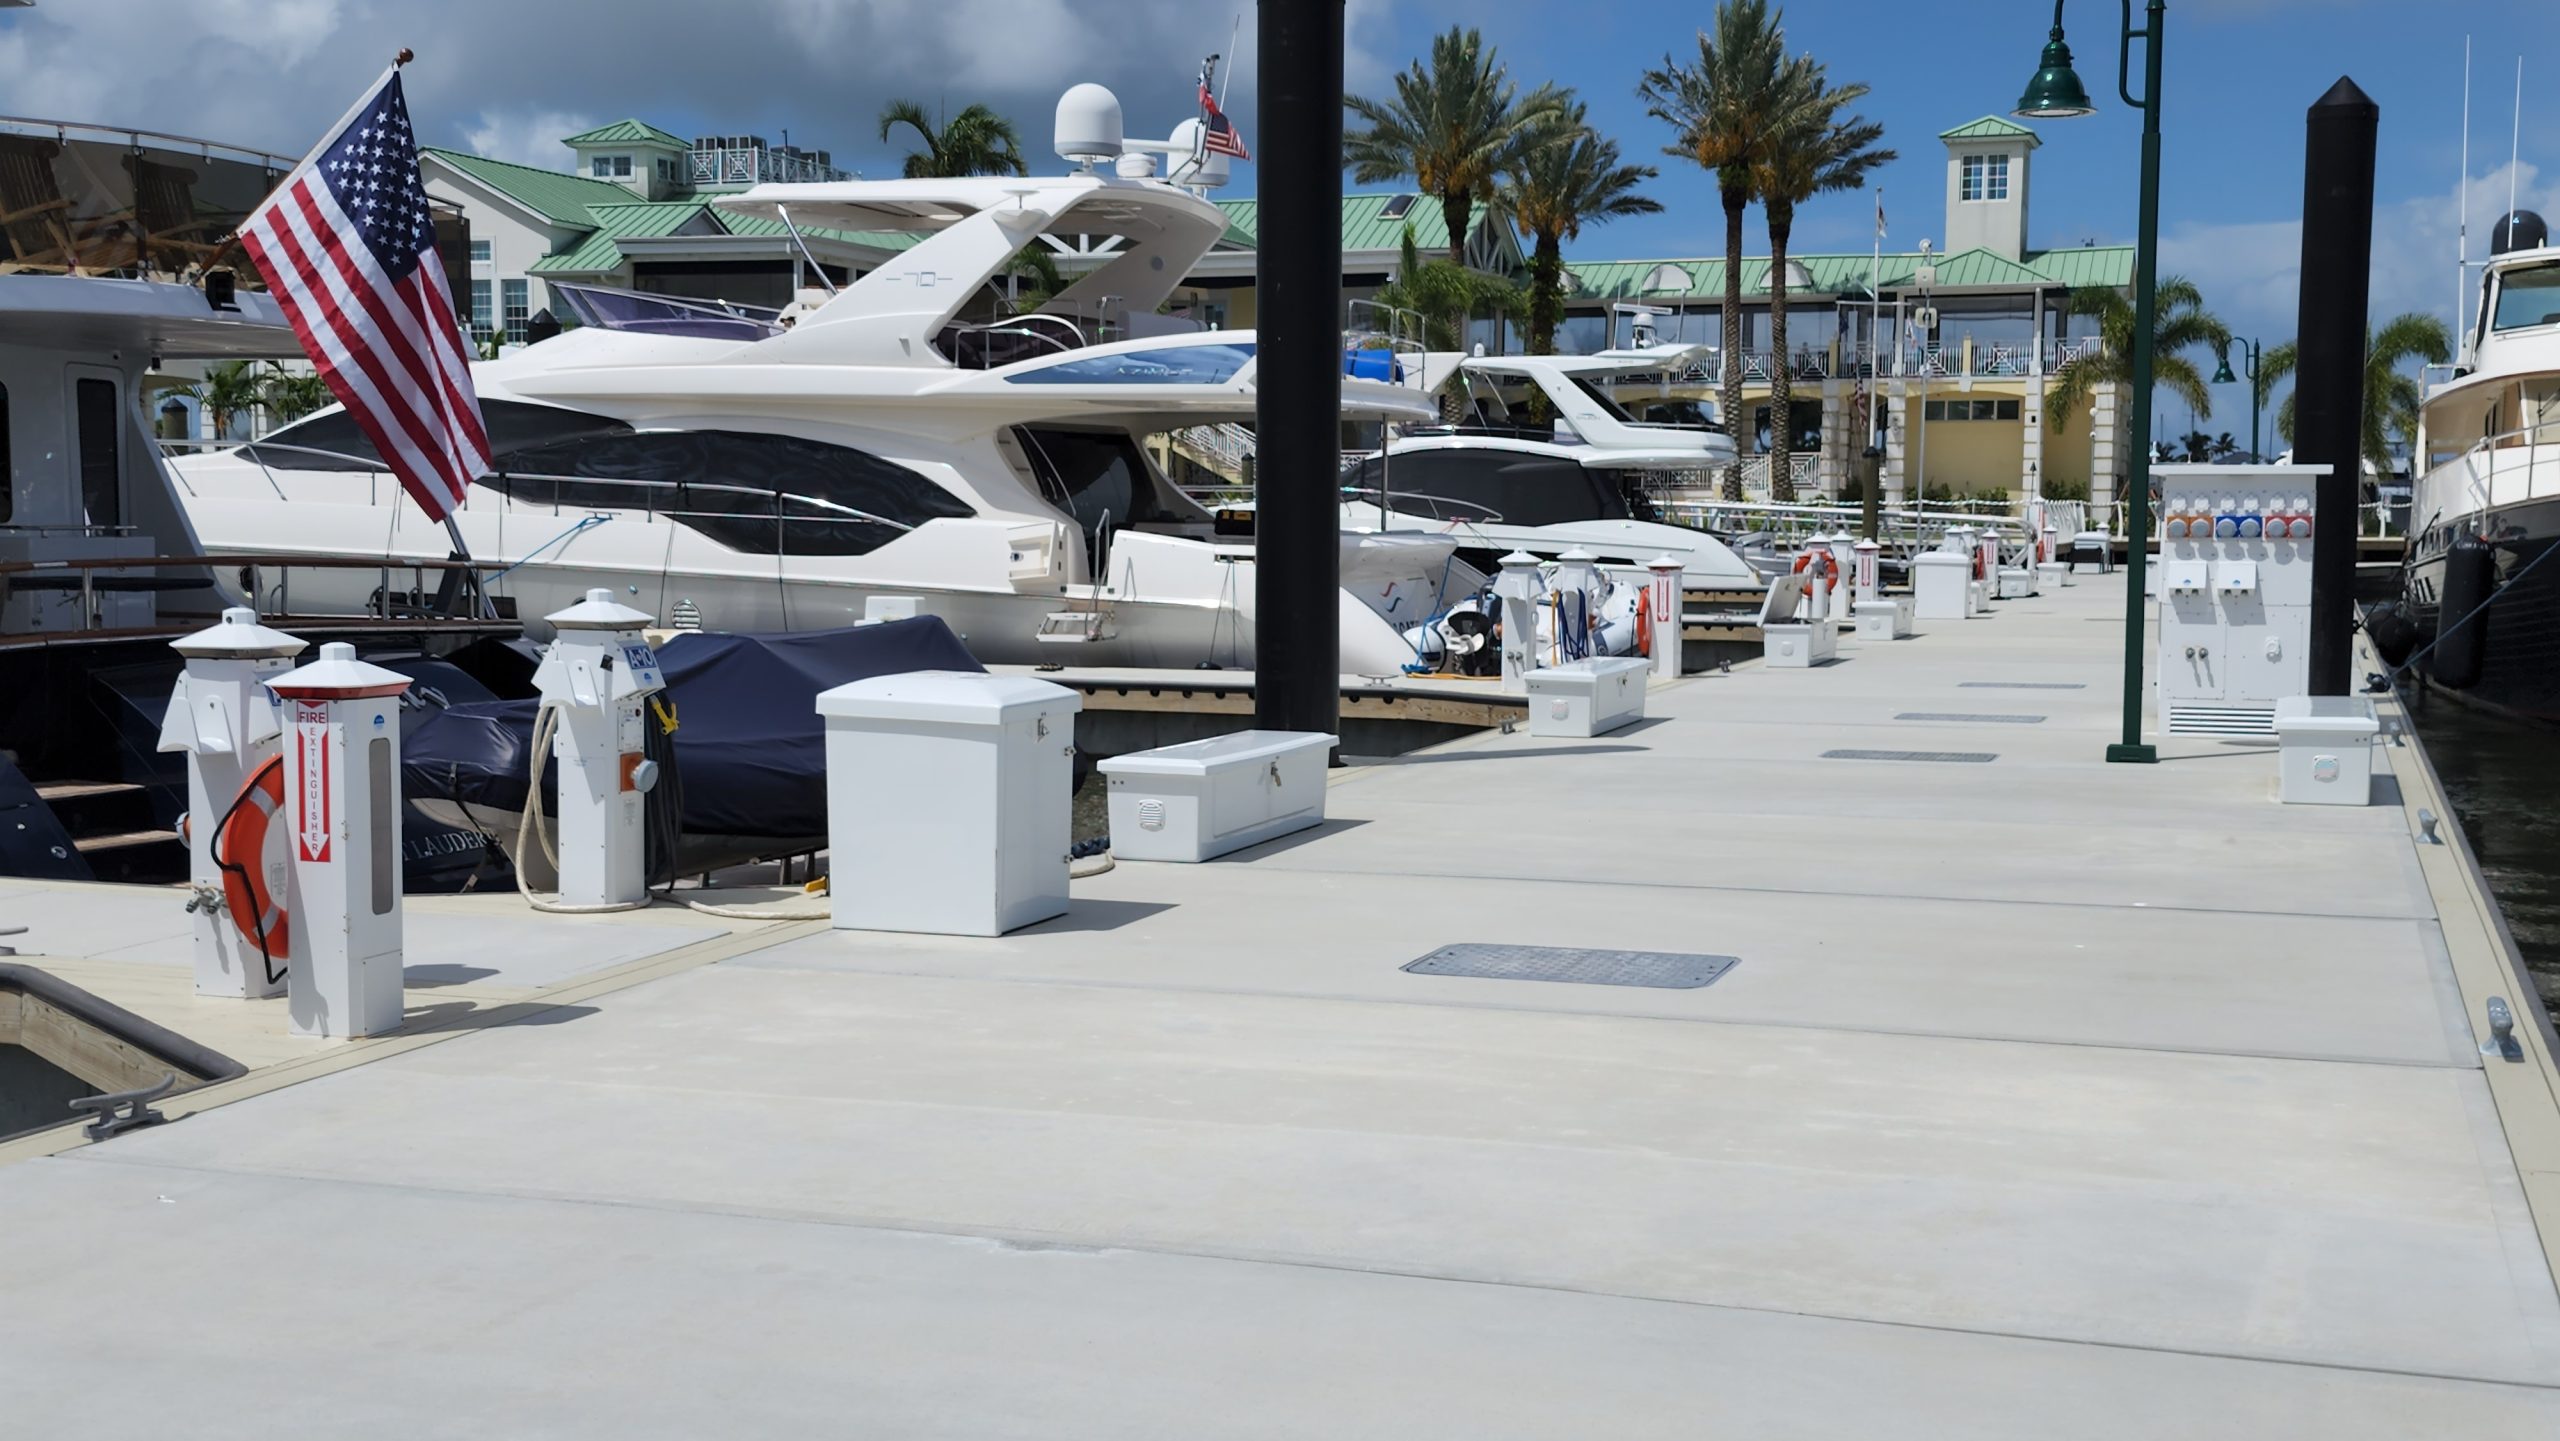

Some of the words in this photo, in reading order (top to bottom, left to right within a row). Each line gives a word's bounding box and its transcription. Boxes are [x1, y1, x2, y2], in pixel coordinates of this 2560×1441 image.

[299, 711, 326, 724] FIRE
[309, 727, 320, 852] EXTINGUISHER
[410, 830, 489, 859] LAUDER
